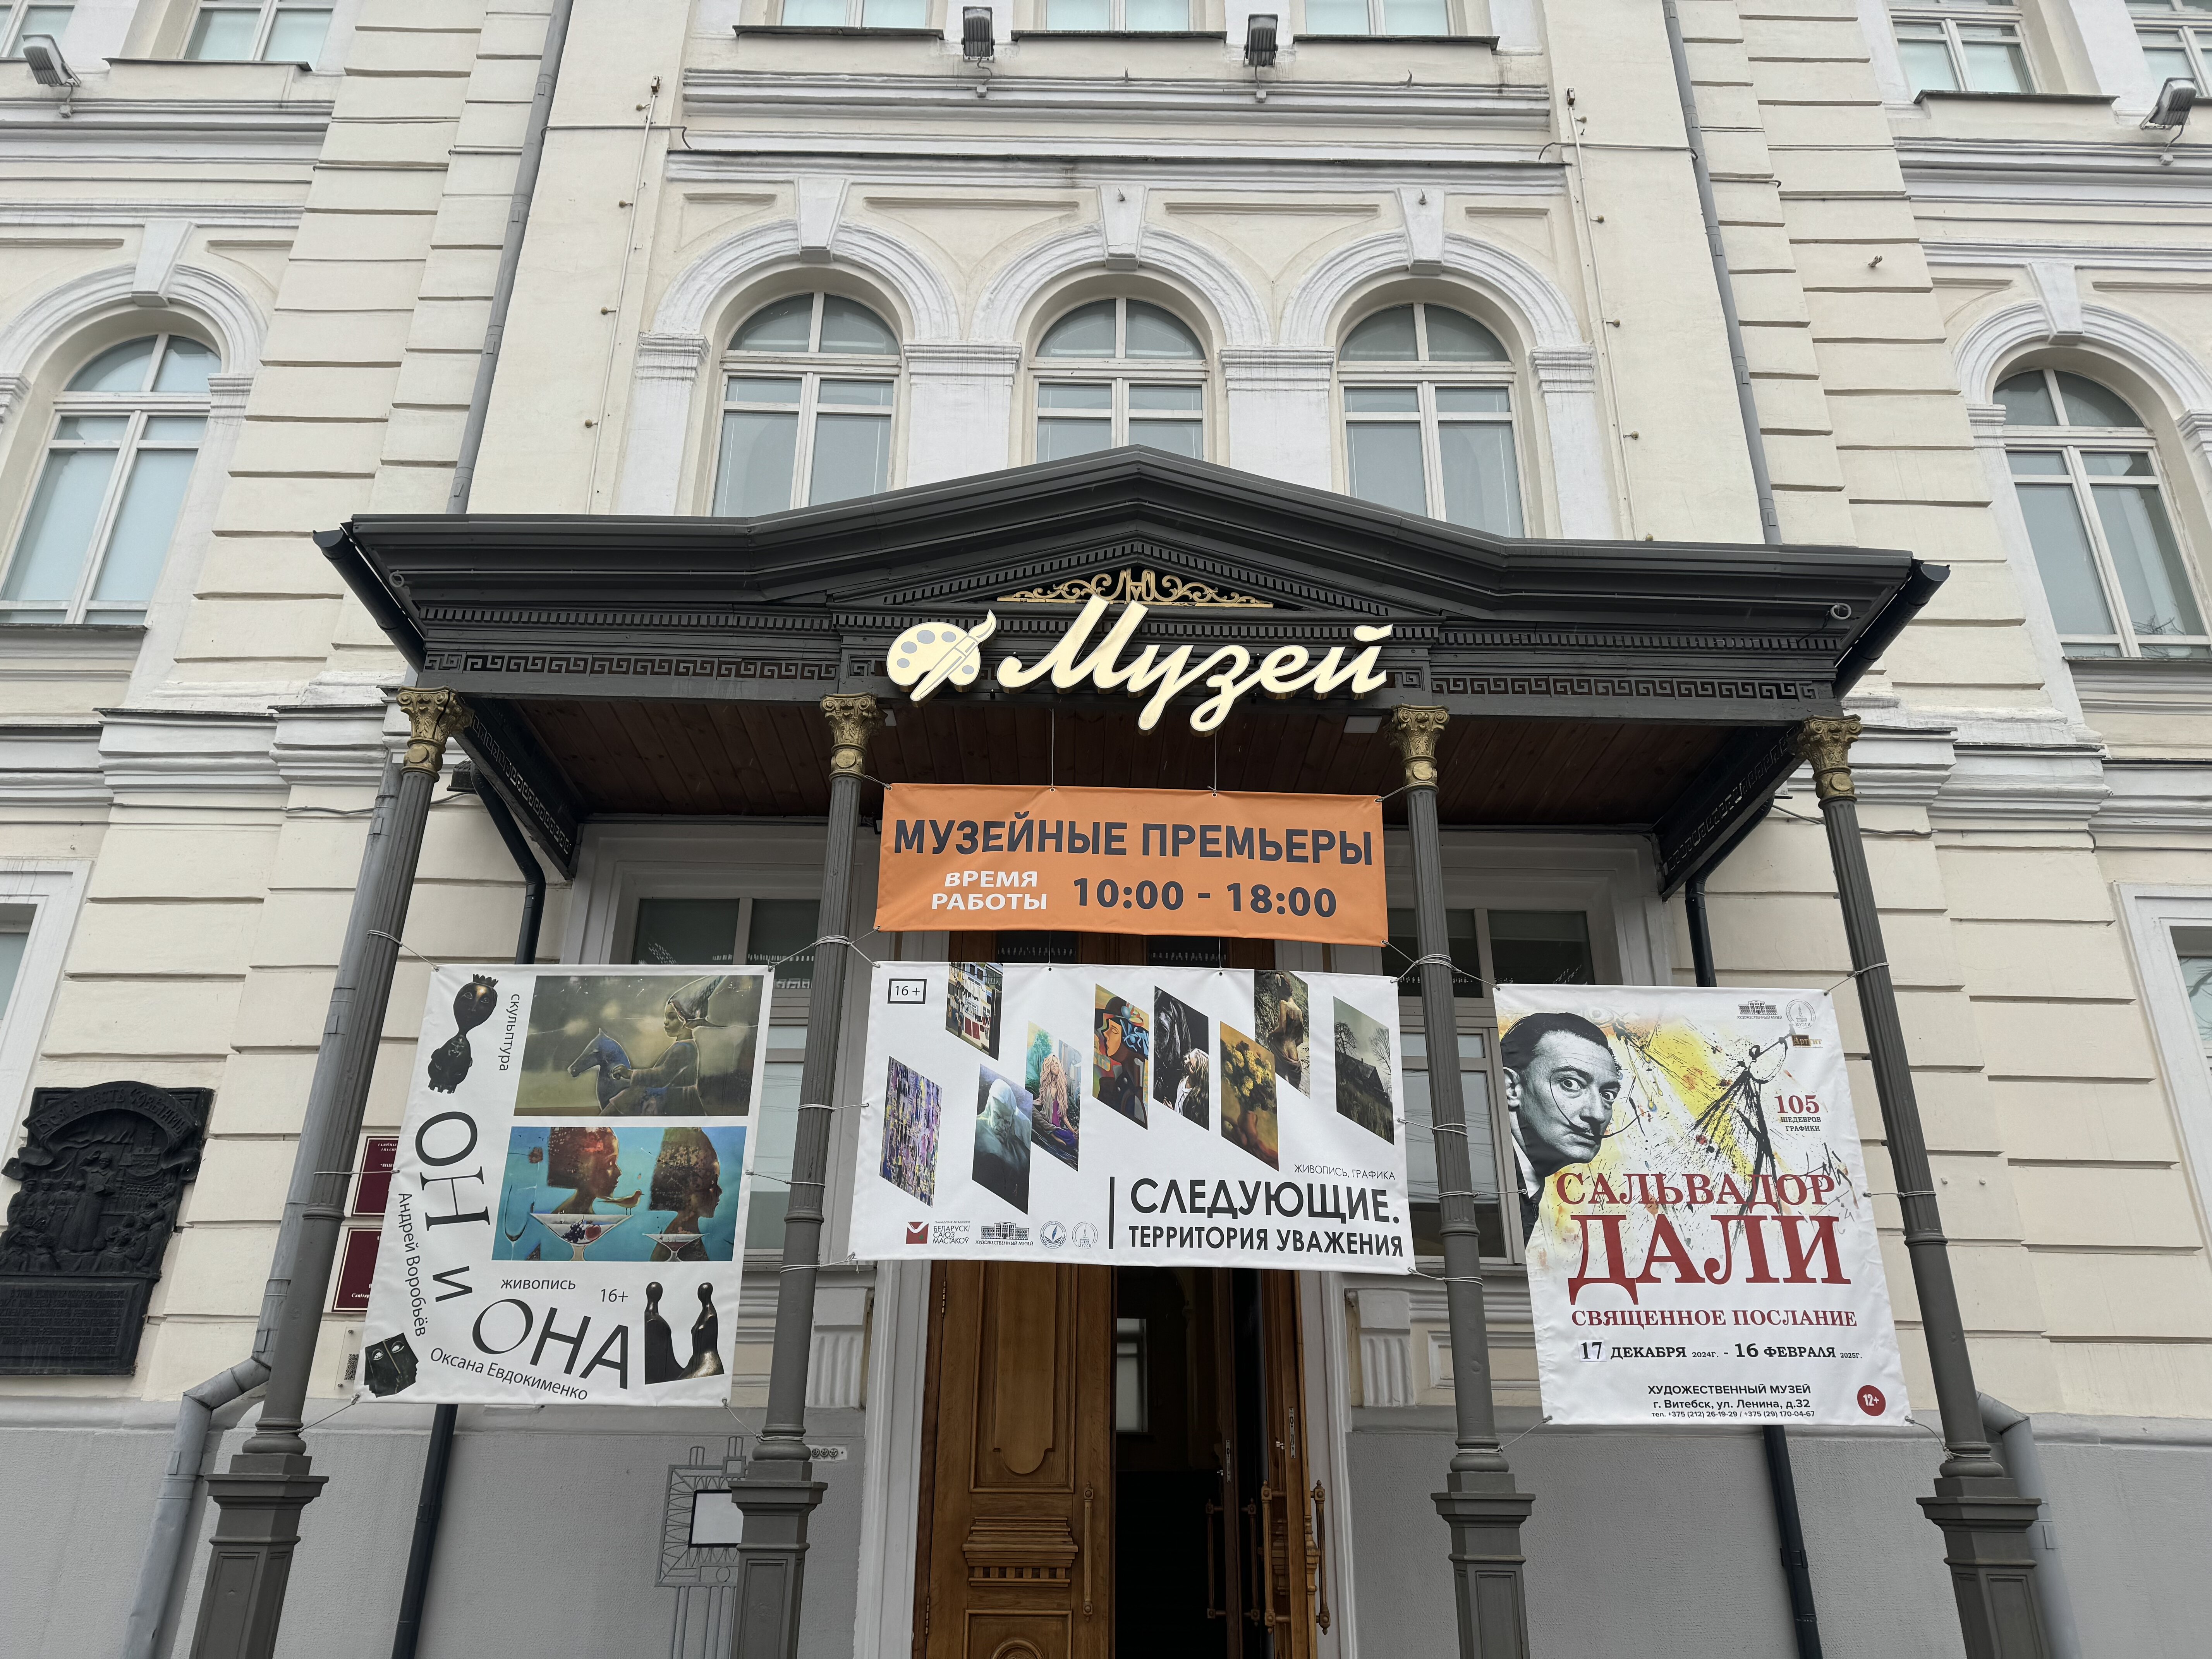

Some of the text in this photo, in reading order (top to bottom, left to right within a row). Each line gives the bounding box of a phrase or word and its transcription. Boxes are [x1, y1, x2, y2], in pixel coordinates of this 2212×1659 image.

[996, 594, 1393, 733] Музей
[894, 810, 1372, 866] МУЗЕЙНЫЕ ПРЕМЬЕРЫ
[944, 870, 1038, 888] ВРЕМЯ
[931, 893, 1047, 910] РАБОТЫ
[1073, 878, 1184, 910] 10:00
[1226, 883, 1337, 918] 18:00
[499, 993, 520, 1071] скульптура
[1774, 1095, 1820, 1114] 105
[1294, 1164, 1396, 1181] ЖИВОПИСЬ, ГРАФИКА
[1130, 1177, 1400, 1224] СЛЕДУЮЩИЕ.
[1128, 1225, 1268, 1251] ТЕРРИТОРИЯ
[1276, 1229, 1403, 1257] УВАЖЕНИЯ
[1555, 1172, 1851, 1305] САЛЬВАДОР ДАЛИ
[398, 1193, 428, 1338] Андрей Воробьёв
[500, 1279, 576, 1290] живопись
[601, 1288, 629, 1303] 16+
[1571, 1310, 1858, 1329] СВЯЩЕННОЕ ПОСЛАНИЕ
[472, 1298, 629, 1391] ОНА
[1580, 1341, 1602, 1360] 17
[1610, 1346, 1688, 1360] ДЕКАБРЯ
[1734, 1343, 1759, 1358] 16
[1763, 1346, 1837, 1358] ФЕВРАЛЯ
[431, 1347, 589, 1400] Оксана Евдокименко
[1647, 1383, 1811, 1396] ХУДОЖЕСТВЕННЫЙ МУЗЕЙ
[1664, 1399, 1714, 1410] Витебск,
[1716, 1401, 1733, 1411] ул.
[1736, 1399, 1783, 1410] Ленина,
[1786, 1399, 1811, 1410] д.32
[1862, 1393, 1880, 1407] 12+
